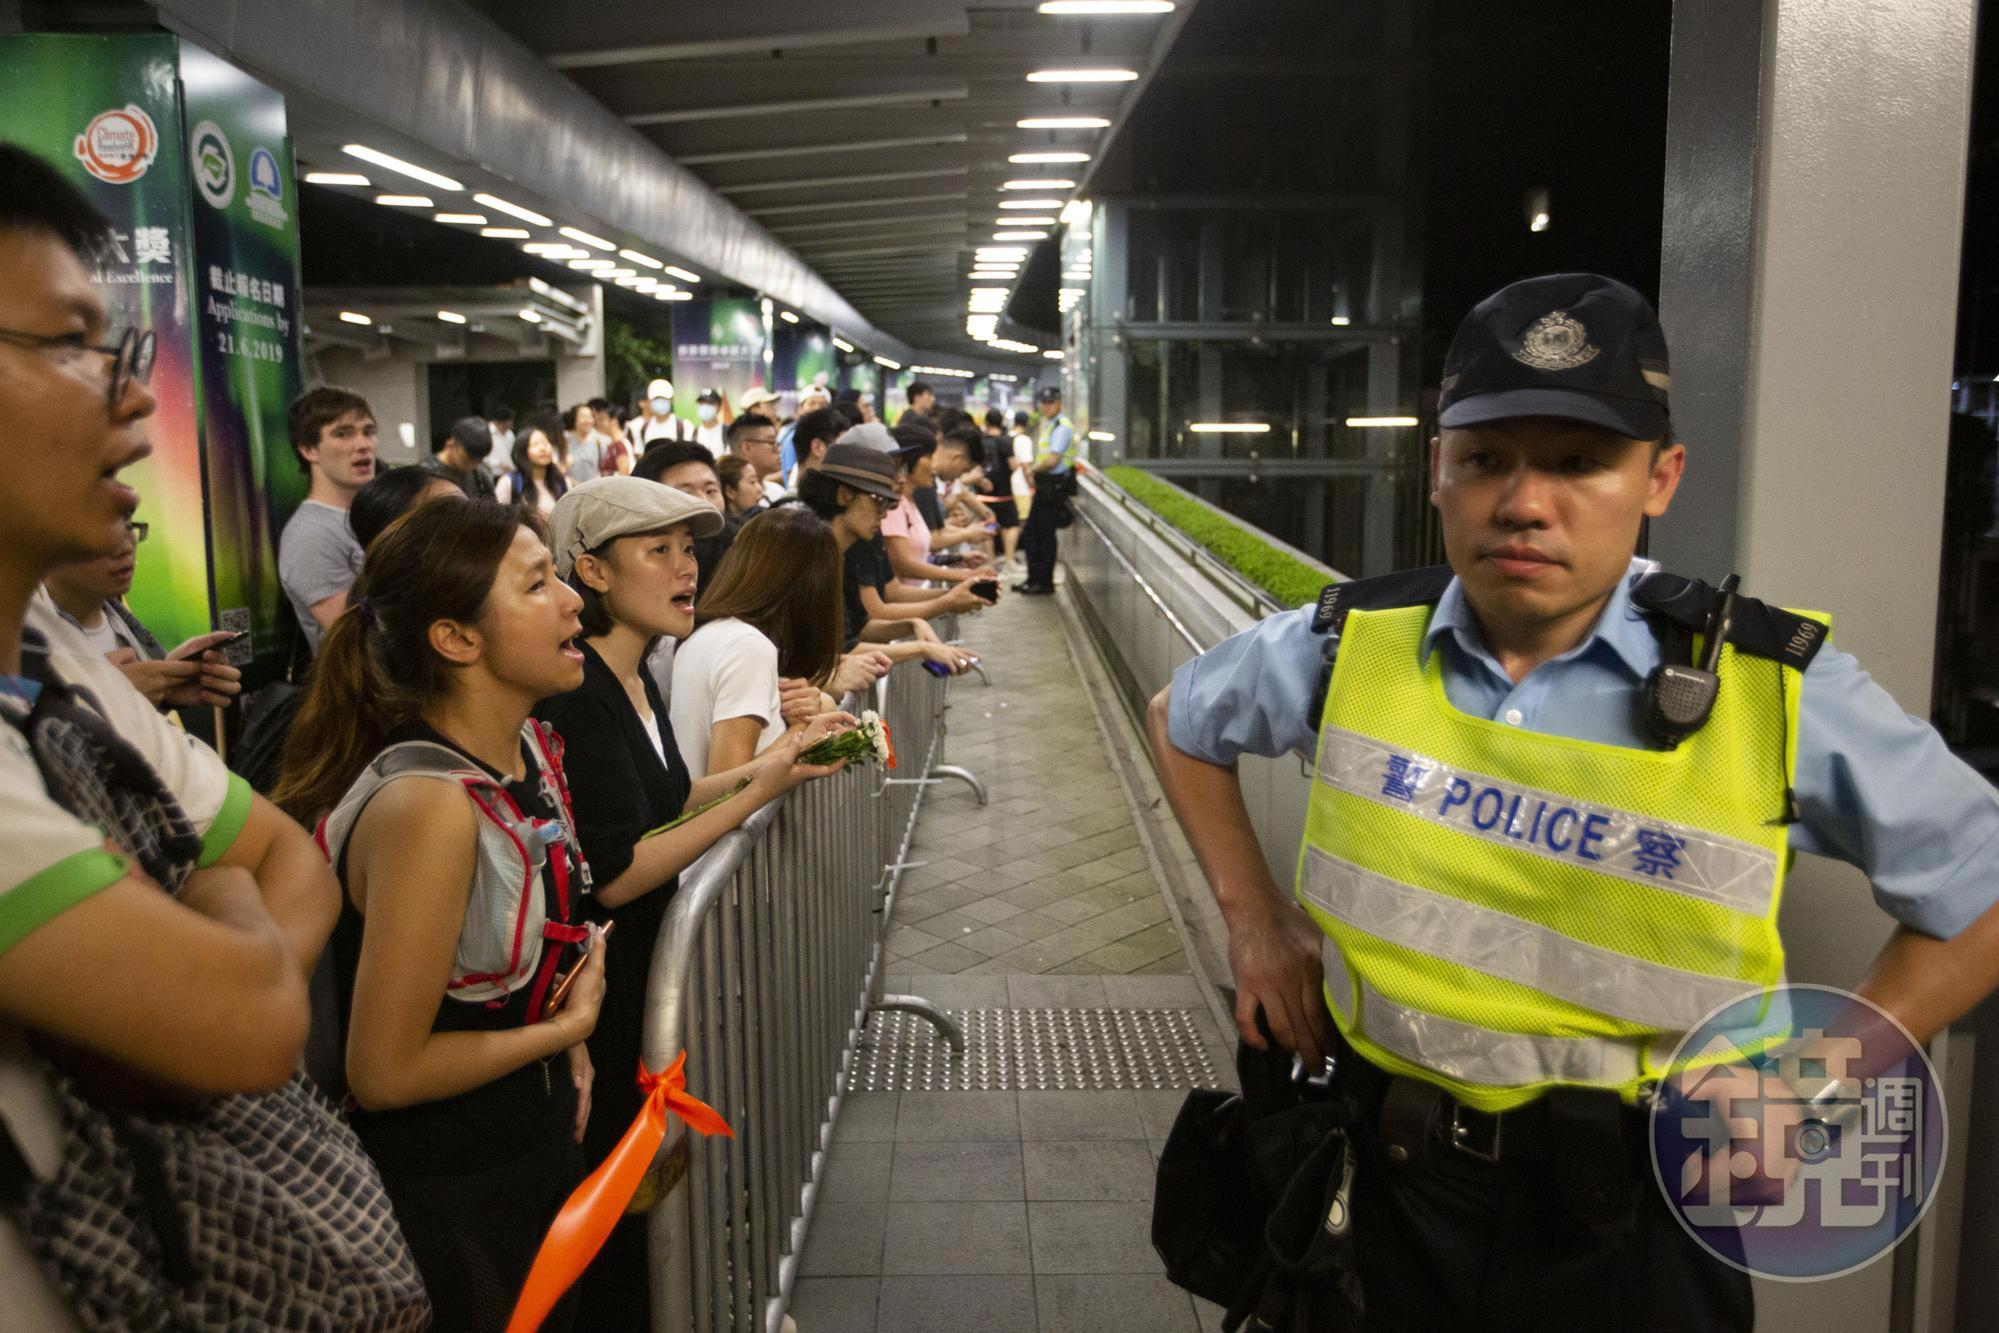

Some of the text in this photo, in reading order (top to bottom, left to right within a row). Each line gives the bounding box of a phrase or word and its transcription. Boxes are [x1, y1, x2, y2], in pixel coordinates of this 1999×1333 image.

[207, 294, 290, 338] Applications by
[217, 331, 283, 363] 21.6.2019
[1319, 586, 1340, 619] 11969
[1785, 622, 1818, 657] 11969
[1381, 753, 1686, 880] 警 POLICE 察
